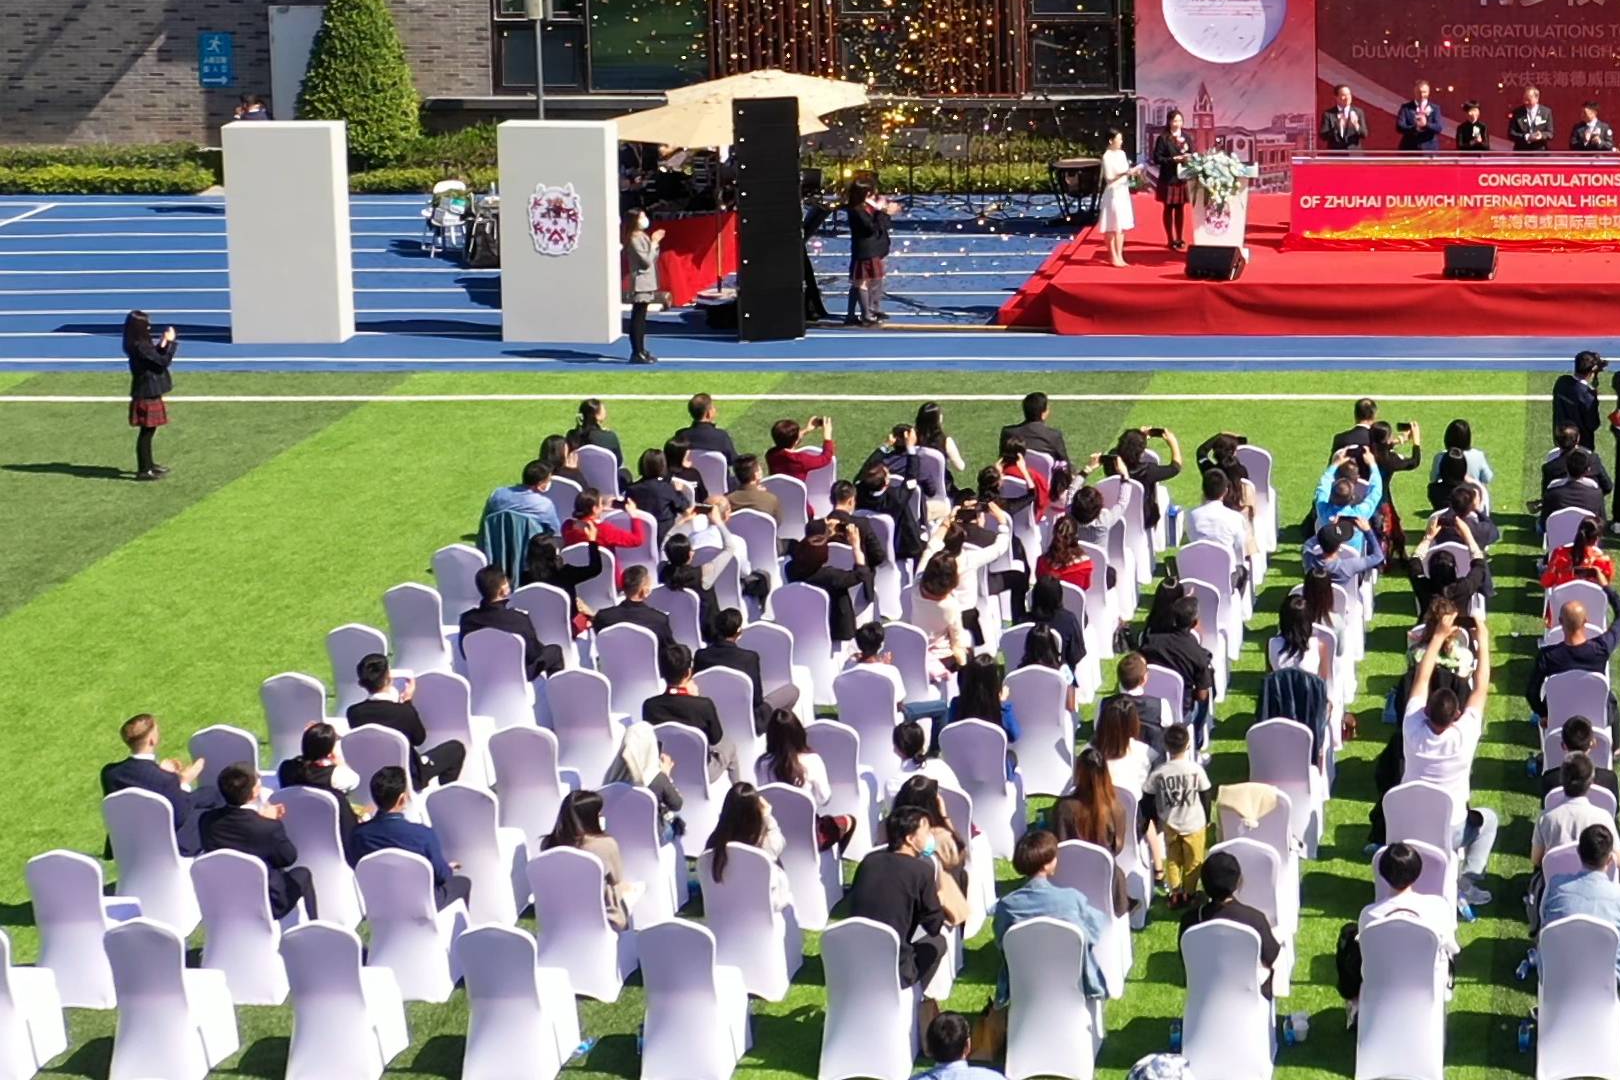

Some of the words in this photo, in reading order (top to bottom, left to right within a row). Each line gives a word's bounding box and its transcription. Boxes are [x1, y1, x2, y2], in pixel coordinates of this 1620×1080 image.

[1441, 24, 1604, 38] CONGRATULATIONS
[1352, 44, 1429, 58] DULWICH
[1434, 44, 1567, 58] INTERNATIONAL
[1571, 44, 1611, 58] HIGH
[1300, 194, 1321, 208] OF
[1324, 194, 1381, 208] ZHUHAI
[1386, 194, 1455, 208] DULWICH
[1460, 194, 1576, 208] INTERNATIONAL
[1580, 194, 1618, 208] HIGH
